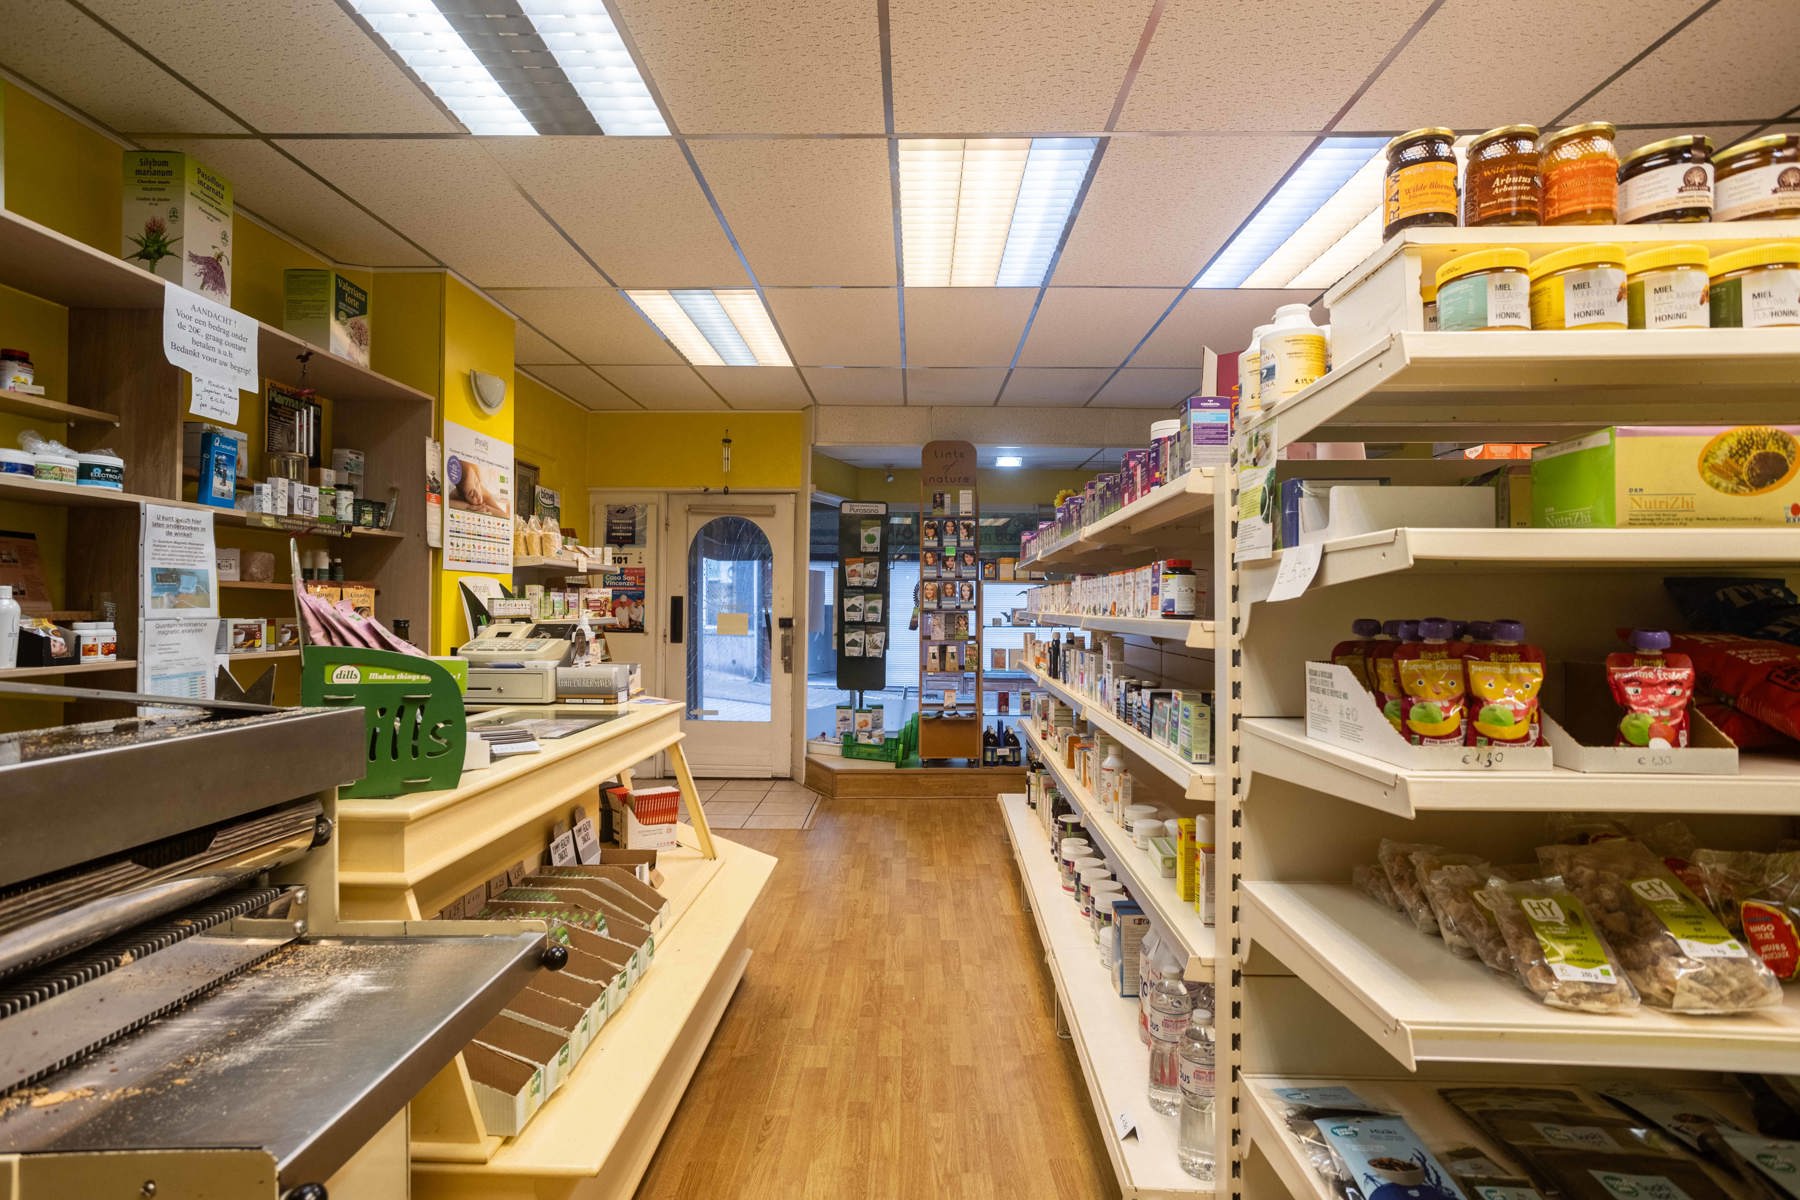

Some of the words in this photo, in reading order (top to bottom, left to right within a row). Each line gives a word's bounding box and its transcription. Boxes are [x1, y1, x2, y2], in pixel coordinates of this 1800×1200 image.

[1495, 283, 1512, 292] MIEL
[1573, 281, 1592, 292] MIEL
[1654, 284, 1673, 295] MIEL
[1752, 290, 1774, 300] MIEL
[191, 303, 232, 326] AANDACHT
[1496, 311, 1521, 320] HONING
[1574, 309, 1606, 320] HONING
[1655, 311, 1688, 323] HONING
[1771, 310, 1799, 319] HONING
[176, 308, 193, 322] Voor
[195, 319, 206, 328] een
[208, 321, 230, 338] bedrag
[231, 332, 249, 343] onder
[177, 321, 186, 331] de
[205, 333, 223, 346] graag
[192, 337, 216, 352] betalen
[170, 341, 201, 358] Bedankt
[202, 353, 218, 364] voor
[219, 359, 228, 367] uw
[928, 475, 970, 484] nature
[1630, 495, 1695, 510] NutriZhi
[335, 669, 360, 681] dills
[369, 672, 396, 680] Makes
[397, 672, 420, 682] things
[368, 702, 454, 763] ills
[1638, 880, 1671, 897] HY
[1527, 901, 1556, 917] HY
